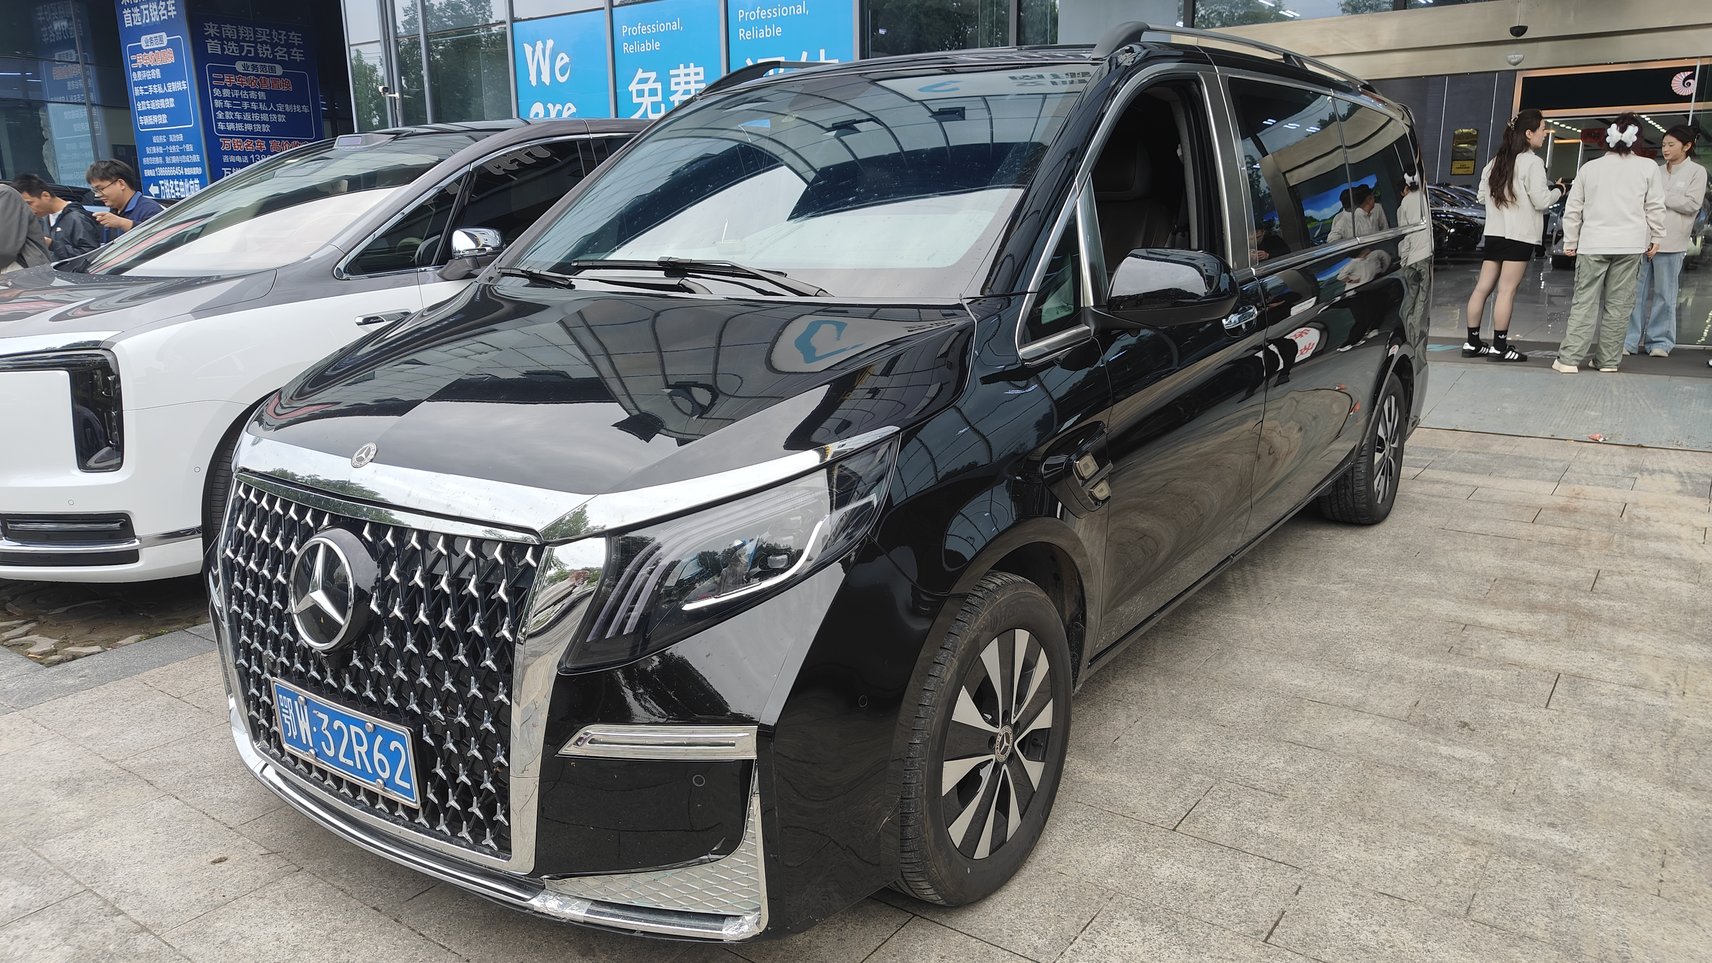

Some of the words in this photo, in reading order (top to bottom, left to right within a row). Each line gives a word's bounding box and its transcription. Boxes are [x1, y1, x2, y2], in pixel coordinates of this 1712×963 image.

[123, 0, 177, 27] 首选万锐名车
[738, 2, 809, 22] Professional,
[203, 21, 303, 46] 来南翔买好车
[622, 17, 683, 37] Professional,
[738, 24, 782, 41] Reliable
[205, 39, 304, 62] 首选万锐名车
[623, 39, 660, 54] Reliable
[241, 63, 278, 74] 业务范围
[523, 39, 571, 87] We
[212, 73, 293, 92] 二手车收售置换
[628, 62, 706, 119] 免费
[213, 88, 266, 100] 免费评估寄售
[213, 99, 310, 113] 新车二手车私人定制找车
[215, 110, 286, 122] 全款车返按揭贷款
[217, 122, 271, 132] 车辆抵押贷款
[220, 138, 267, 152] 万锐名车
[222, 154, 249, 163] 咨询电话
